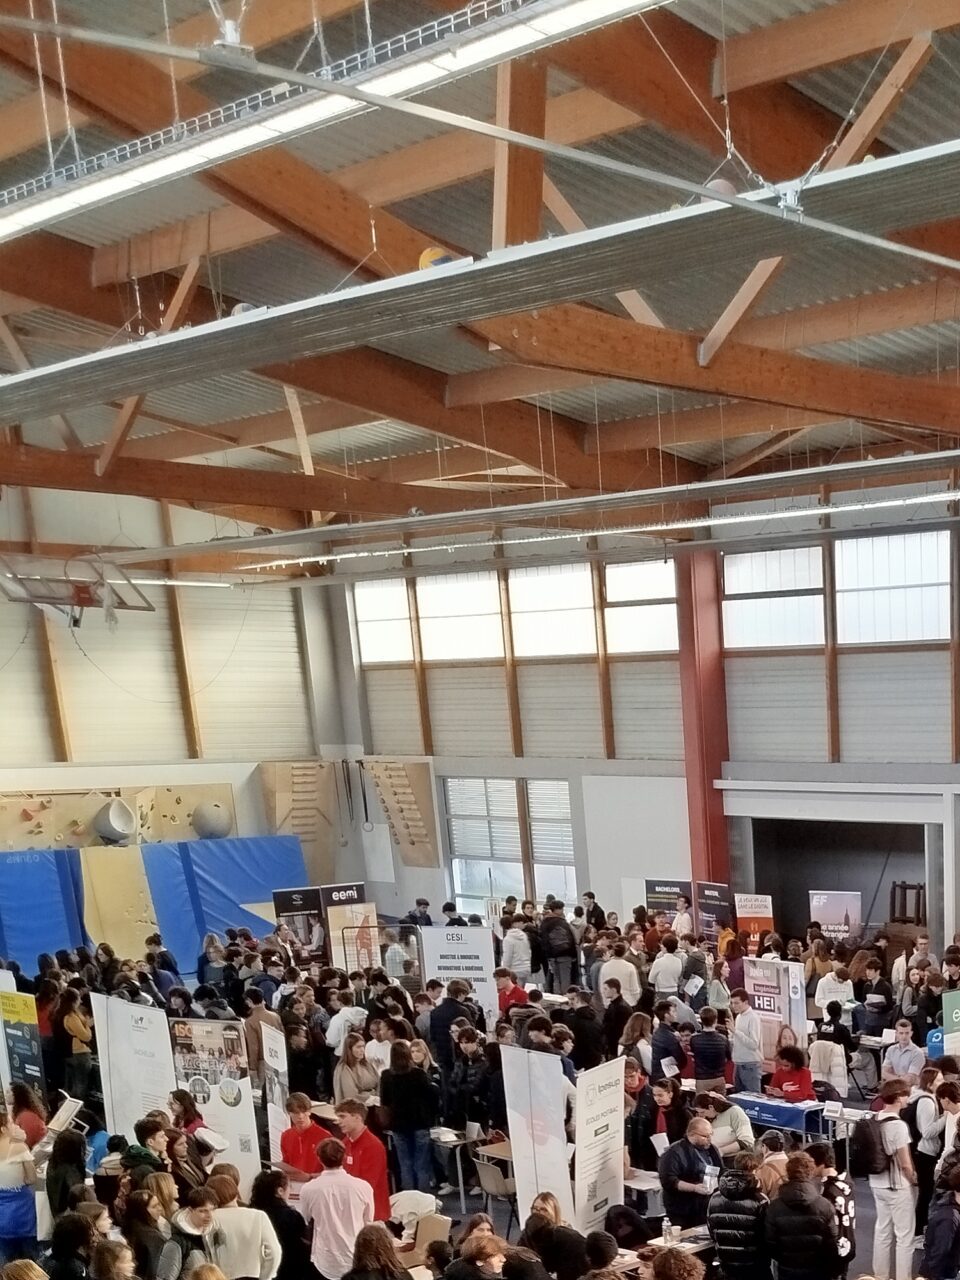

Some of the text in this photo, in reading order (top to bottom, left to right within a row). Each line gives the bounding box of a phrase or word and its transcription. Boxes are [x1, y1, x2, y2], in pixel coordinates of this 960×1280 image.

[332, 886, 358, 900] eemi
[813, 895, 828, 905] EF
[446, 933, 463, 942] CESI
[754, 996, 774, 1010] HEI
